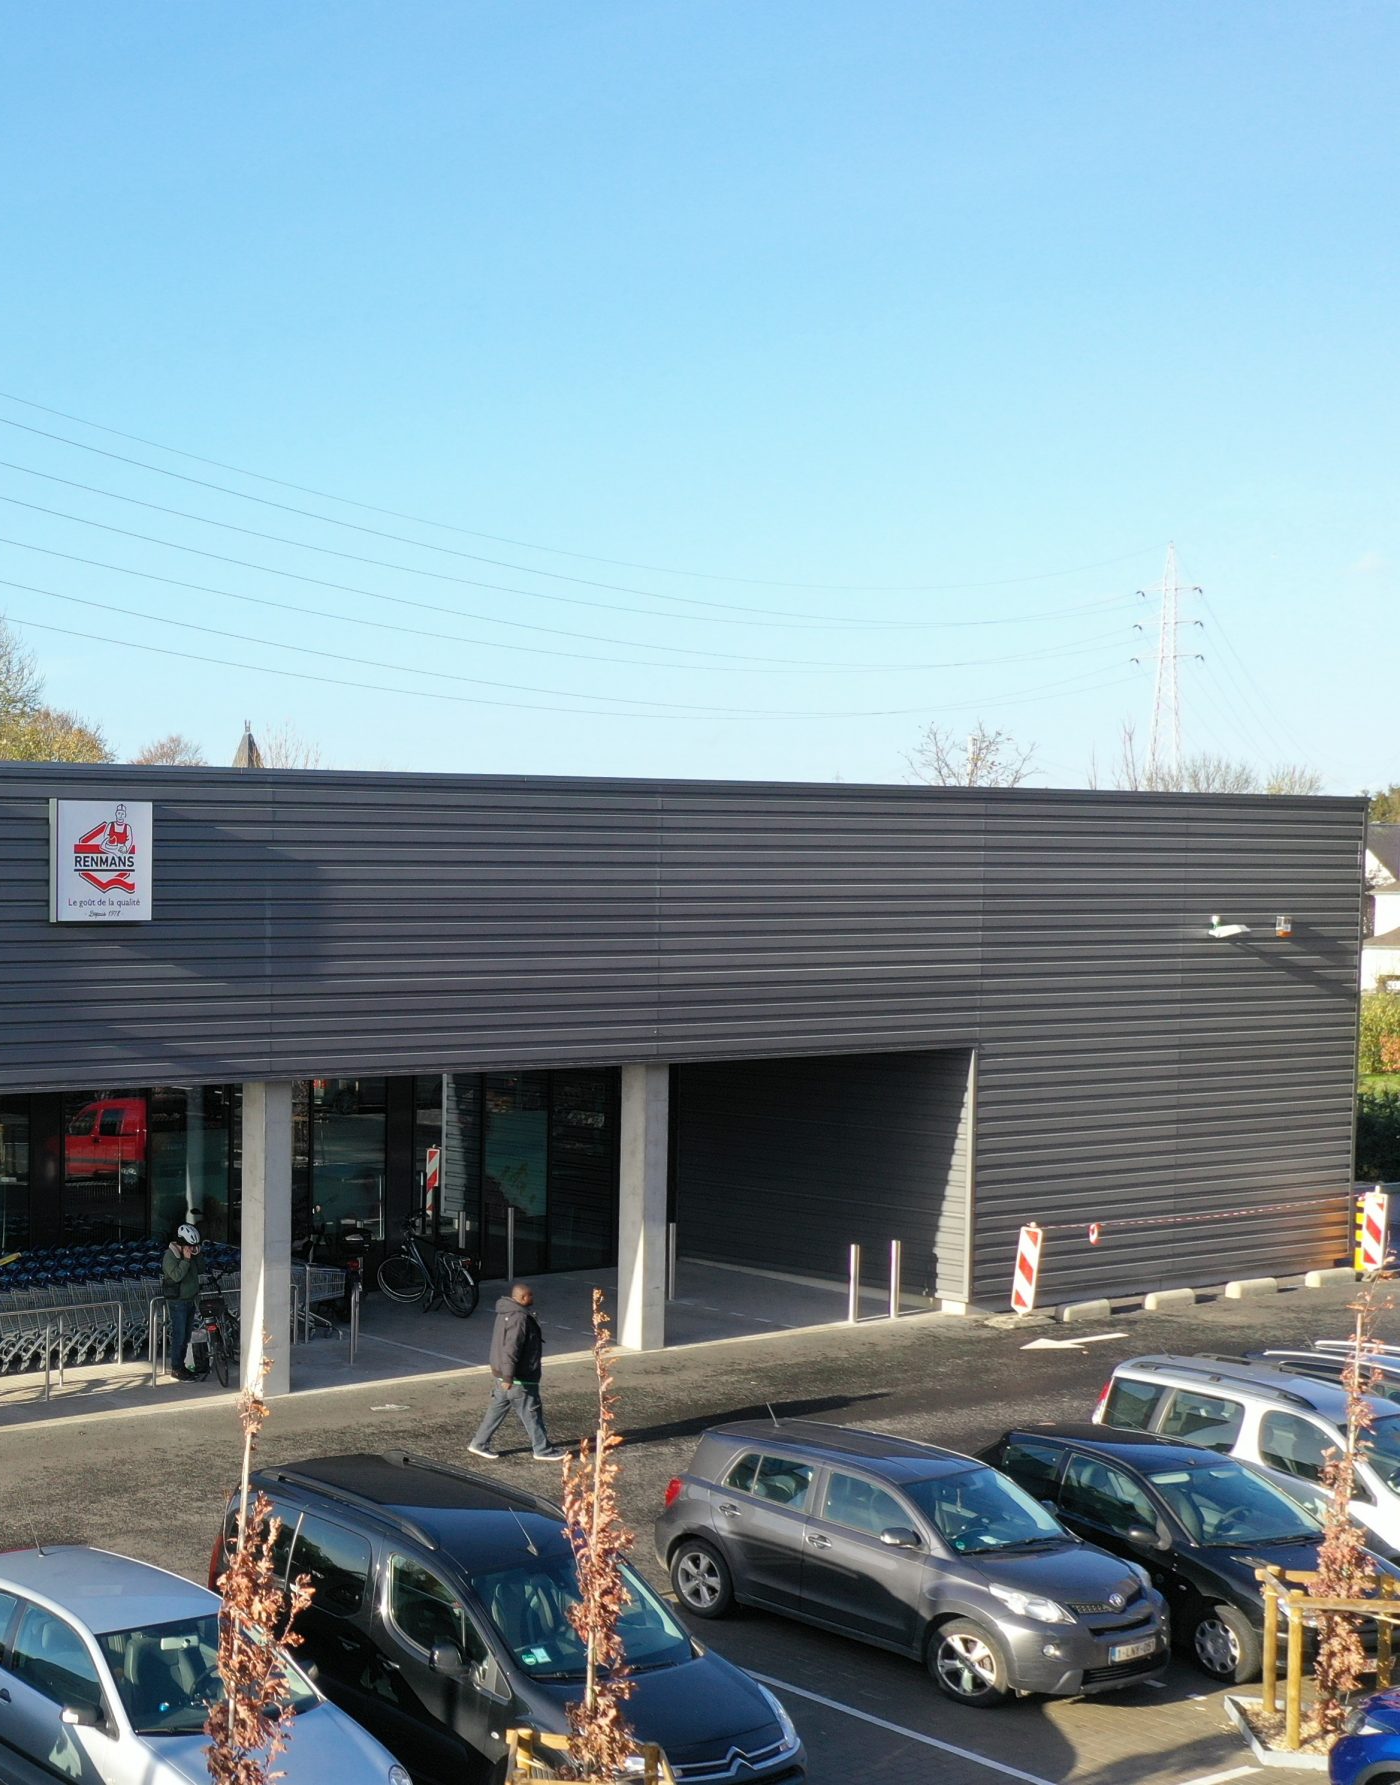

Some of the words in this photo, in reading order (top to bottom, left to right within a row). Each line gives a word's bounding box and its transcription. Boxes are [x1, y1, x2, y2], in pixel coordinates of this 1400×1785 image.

[74, 855, 135, 868] RENMANS
[68, 898, 78, 906] Le
[97, 897, 107, 906] de
[108, 897, 115, 906] la
[116, 897, 141, 908] qualité
